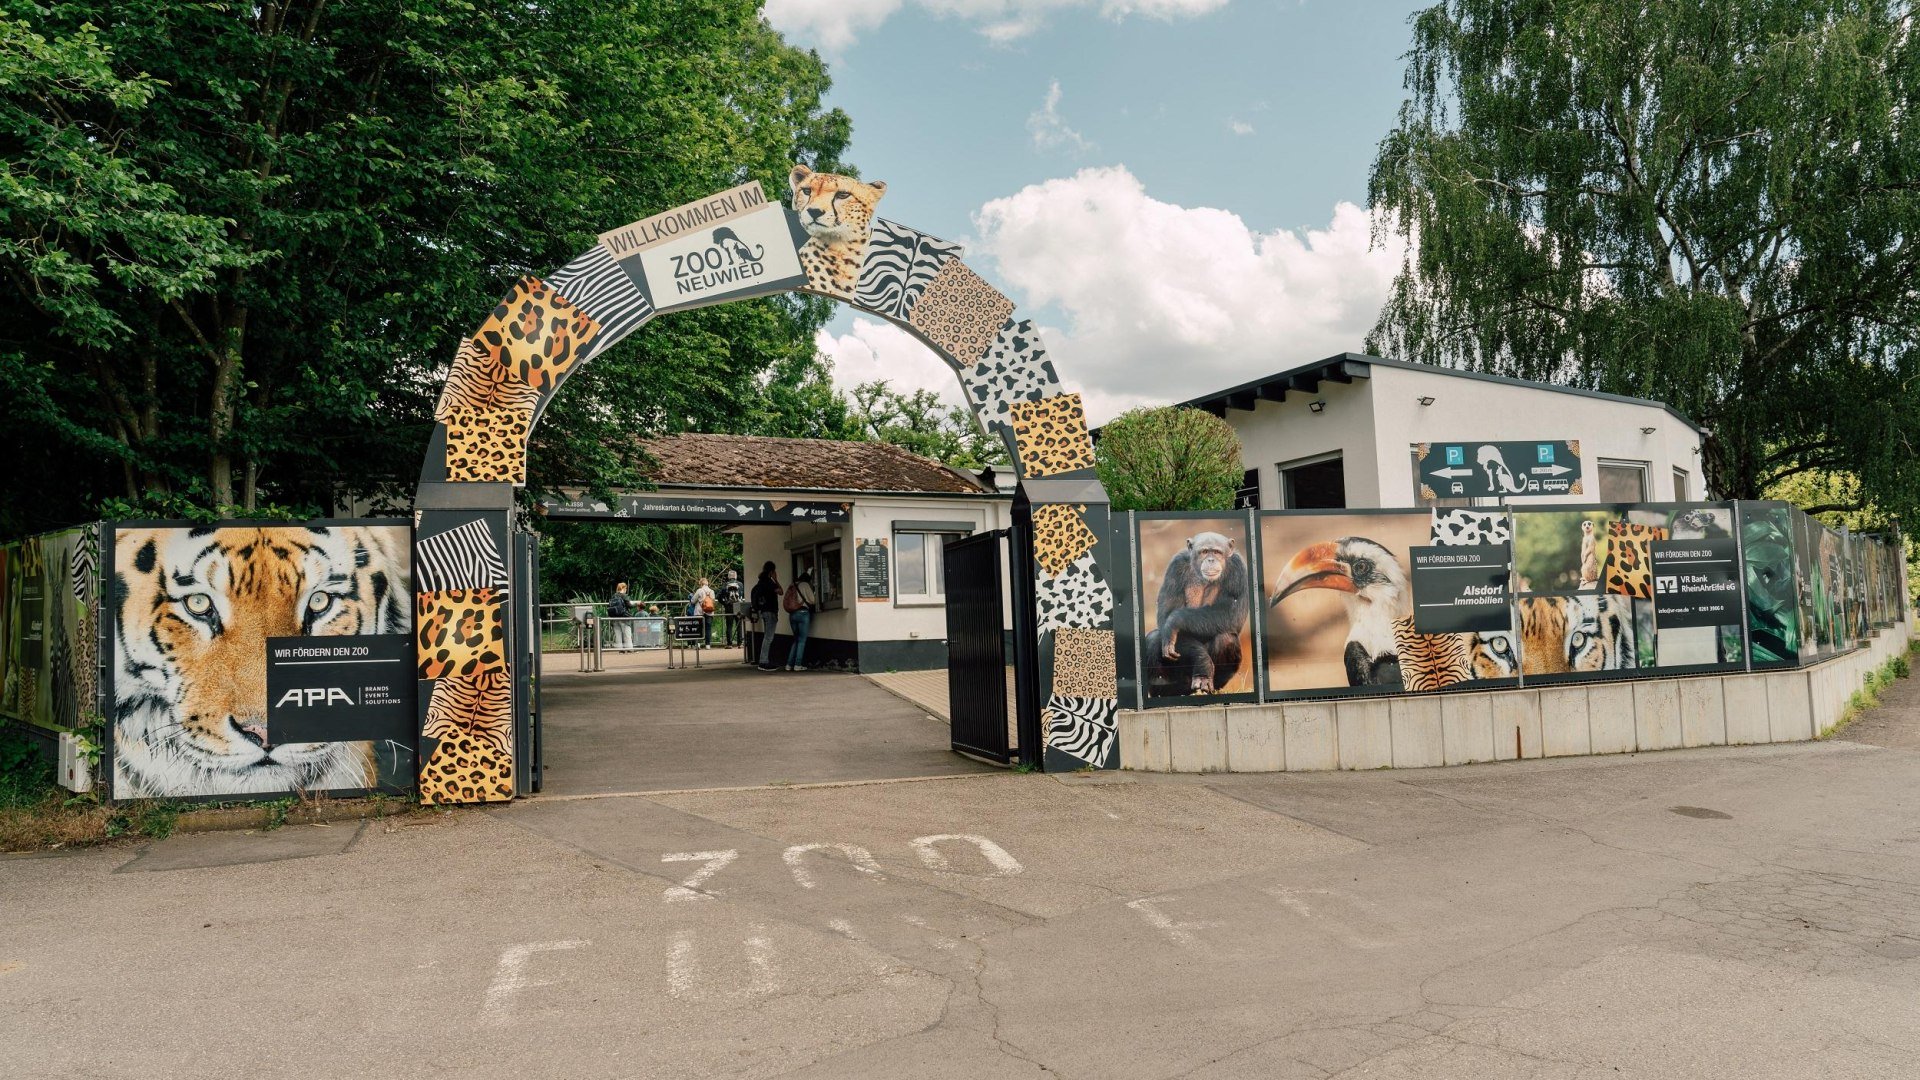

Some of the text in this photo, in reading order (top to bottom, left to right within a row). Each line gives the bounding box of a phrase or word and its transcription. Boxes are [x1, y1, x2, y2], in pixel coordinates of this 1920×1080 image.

[606, 186, 764, 255] WILLKOMMEN IM
[669, 247, 722, 279] ZOO
[676, 262, 764, 295] NEUWIED
[642, 503, 680, 512] Jahreskarten
[687, 504, 726, 513] Online-Tickets
[1416, 556, 1428, 564] WIR
[1428, 554, 1455, 563] FÖRDERN
[1468, 554, 1481, 562] ZOO
[1654, 551, 1665, 559] WIR
[1665, 550, 1690, 558] FÖRDERN
[1690, 550, 1701, 558] DEN
[1680, 574, 1708, 583] VR Bank
[1463, 584, 1503, 596] Alsdorf
[1681, 583, 1736, 593] RheinAhrEifel eG
[1454, 596, 1503, 606] Immobilien
[274, 647, 369, 658] WIR FÖRDERN DEN ZOO
[274, 687, 355, 708] APA
